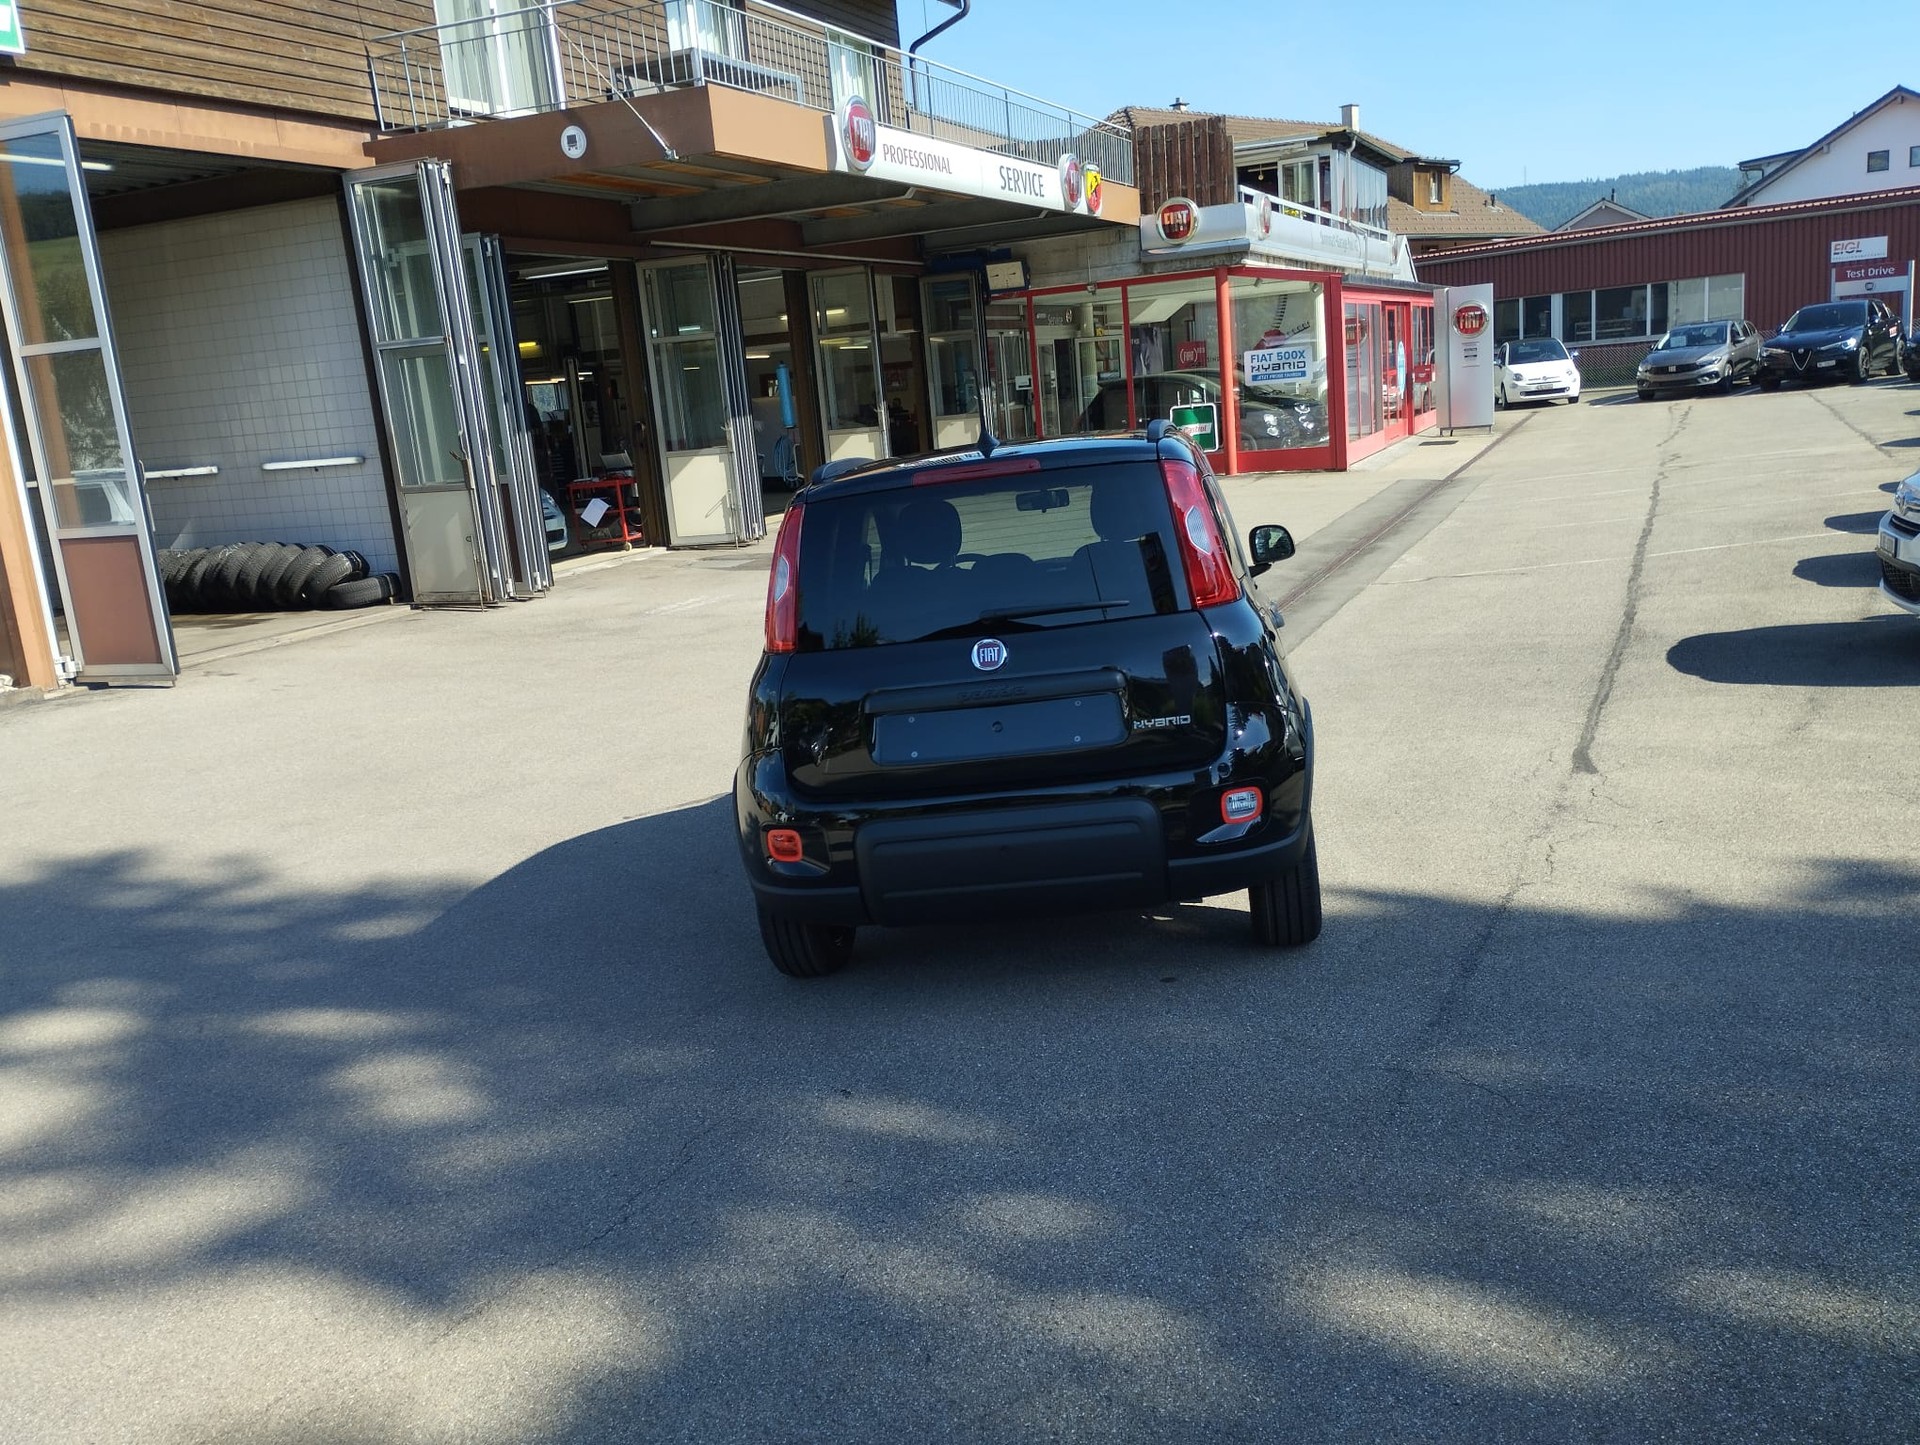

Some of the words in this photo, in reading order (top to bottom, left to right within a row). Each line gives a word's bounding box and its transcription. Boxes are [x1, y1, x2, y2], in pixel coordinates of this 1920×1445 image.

[882, 143, 953, 175] PROFESSIONAL
[998, 164, 1045, 198] SERVICE
[1846, 268, 1865, 279] Test
[1867, 266, 1895, 277] Drive
[1250, 353, 1273, 363] FIAT
[1277, 350, 1306, 360] 500X
[1250, 361, 1306, 373] HYBRID
[1183, 424, 1207, 435] Castrol
[979, 646, 1000, 663] FIAT
[1133, 714, 1191, 730] HYBRID
